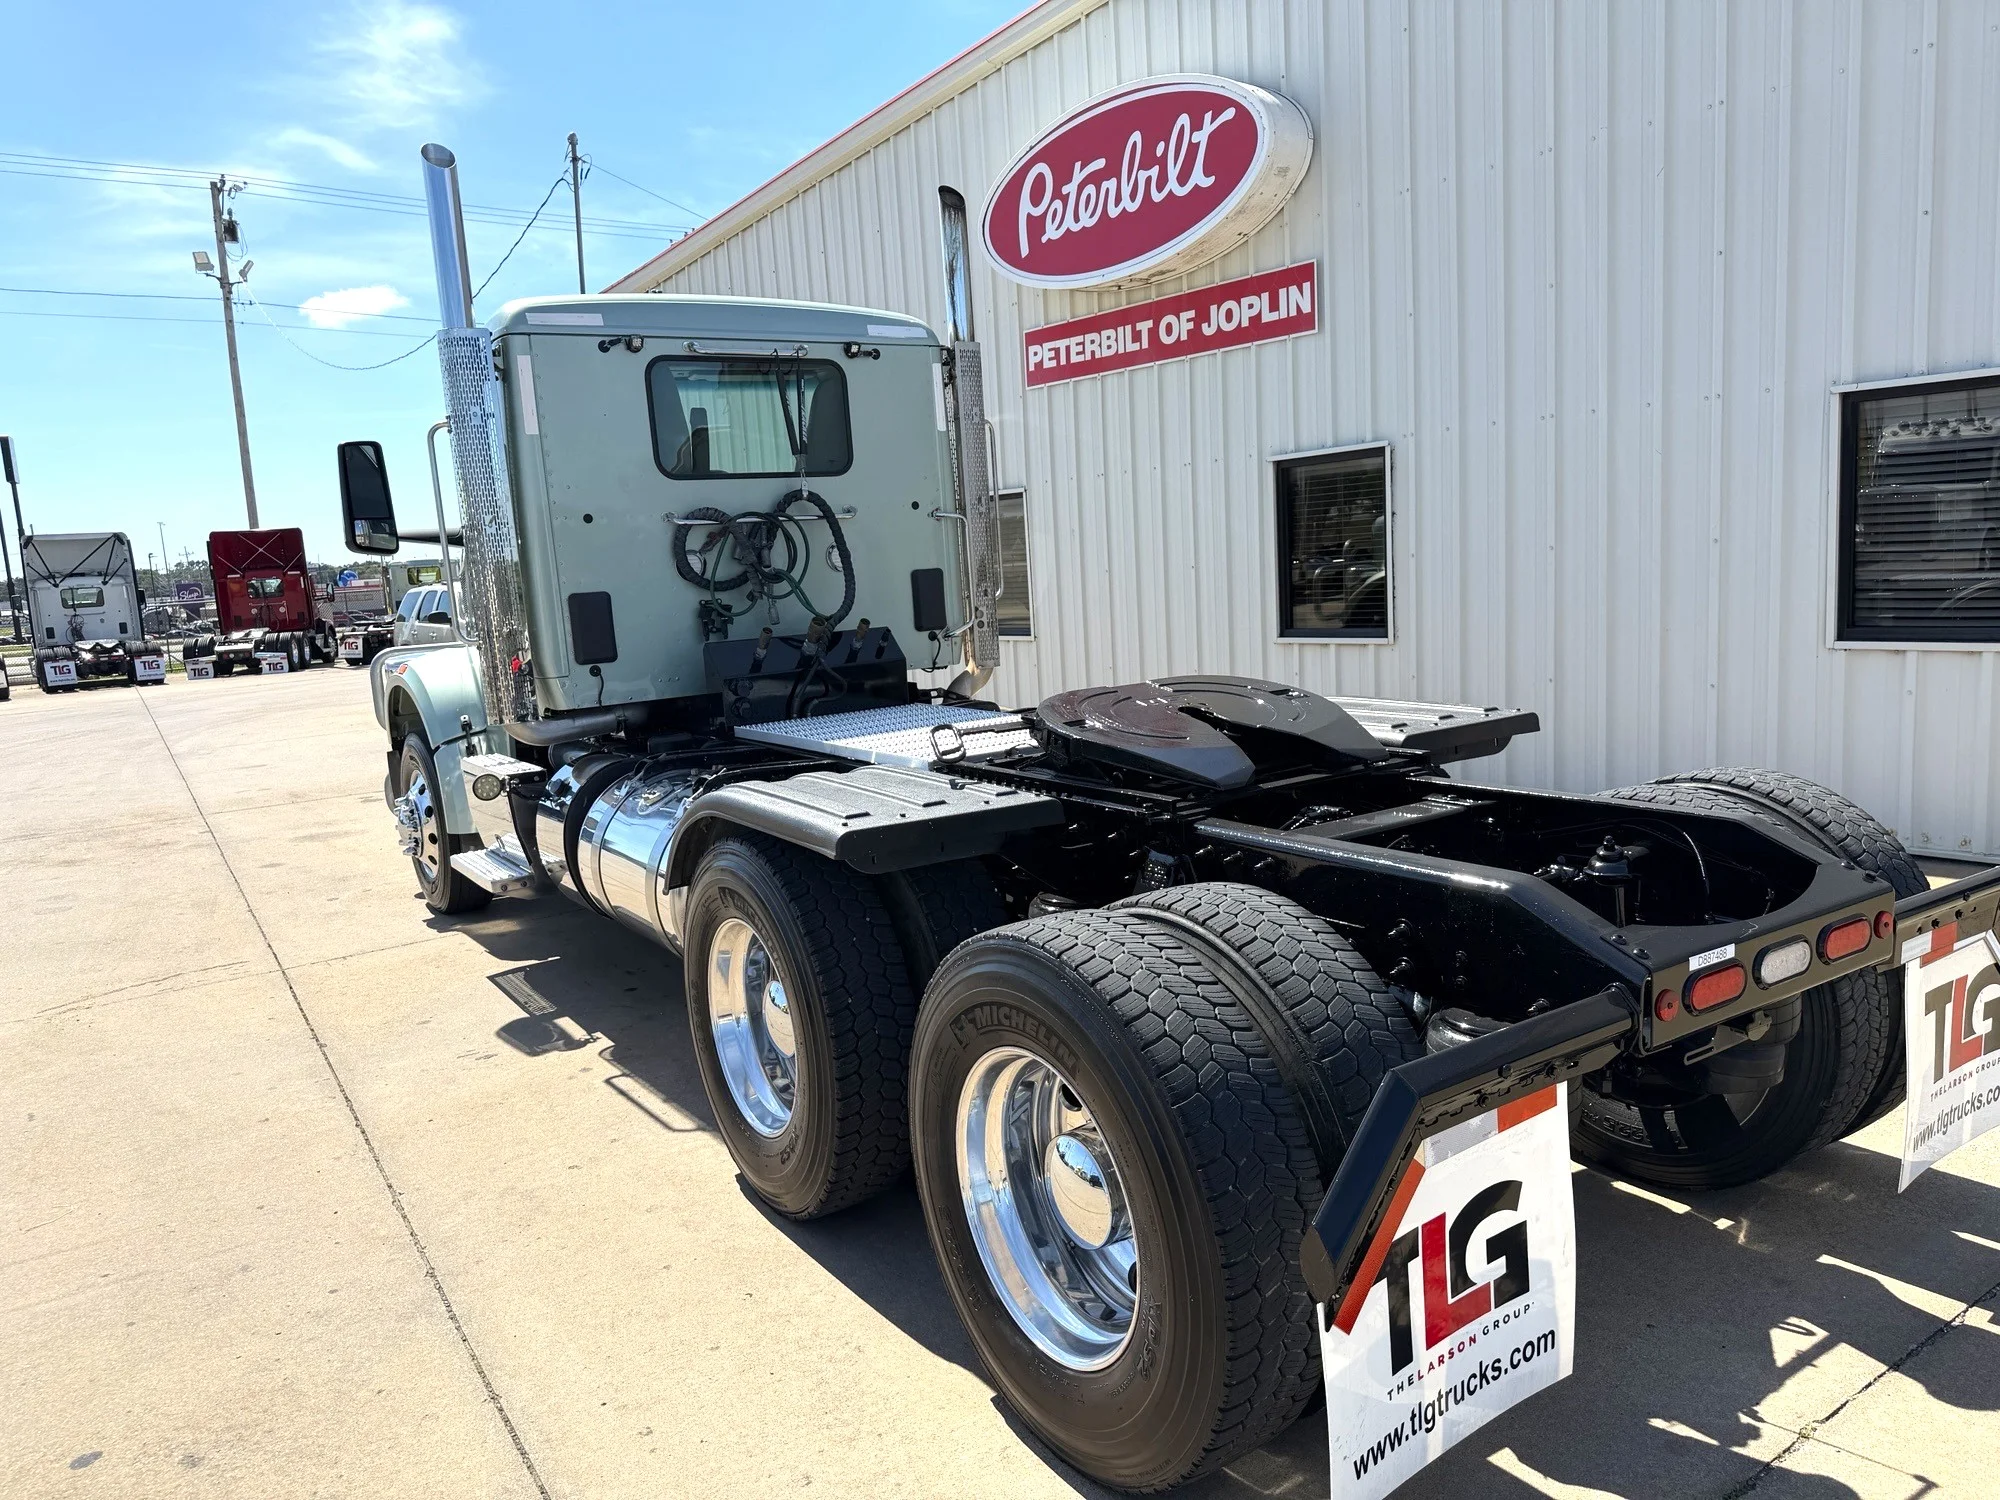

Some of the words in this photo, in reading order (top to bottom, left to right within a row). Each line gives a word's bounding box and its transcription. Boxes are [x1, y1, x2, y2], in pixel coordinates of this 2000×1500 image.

[1018, 107, 1236, 258] Peterbilt
[1028, 320, 1152, 371] PETERBILT
[1159, 310, 1195, 344] OF
[1201, 282, 1311, 336] JOPLIN
[50, 664, 71, 676] TLG
[140, 660, 160, 670] TLG
[190, 667, 209, 677] TLG
[265, 662, 284, 671] TLG
[974, 1005, 1077, 1068] MICHELIN
[1925, 963, 2000, 1084] TLG
[1371, 1180, 1530, 1377] TLG
[1482, 1304, 1531, 1336] GROUP
[1353, 1329, 1556, 1480] www.tlgtrucks.com
